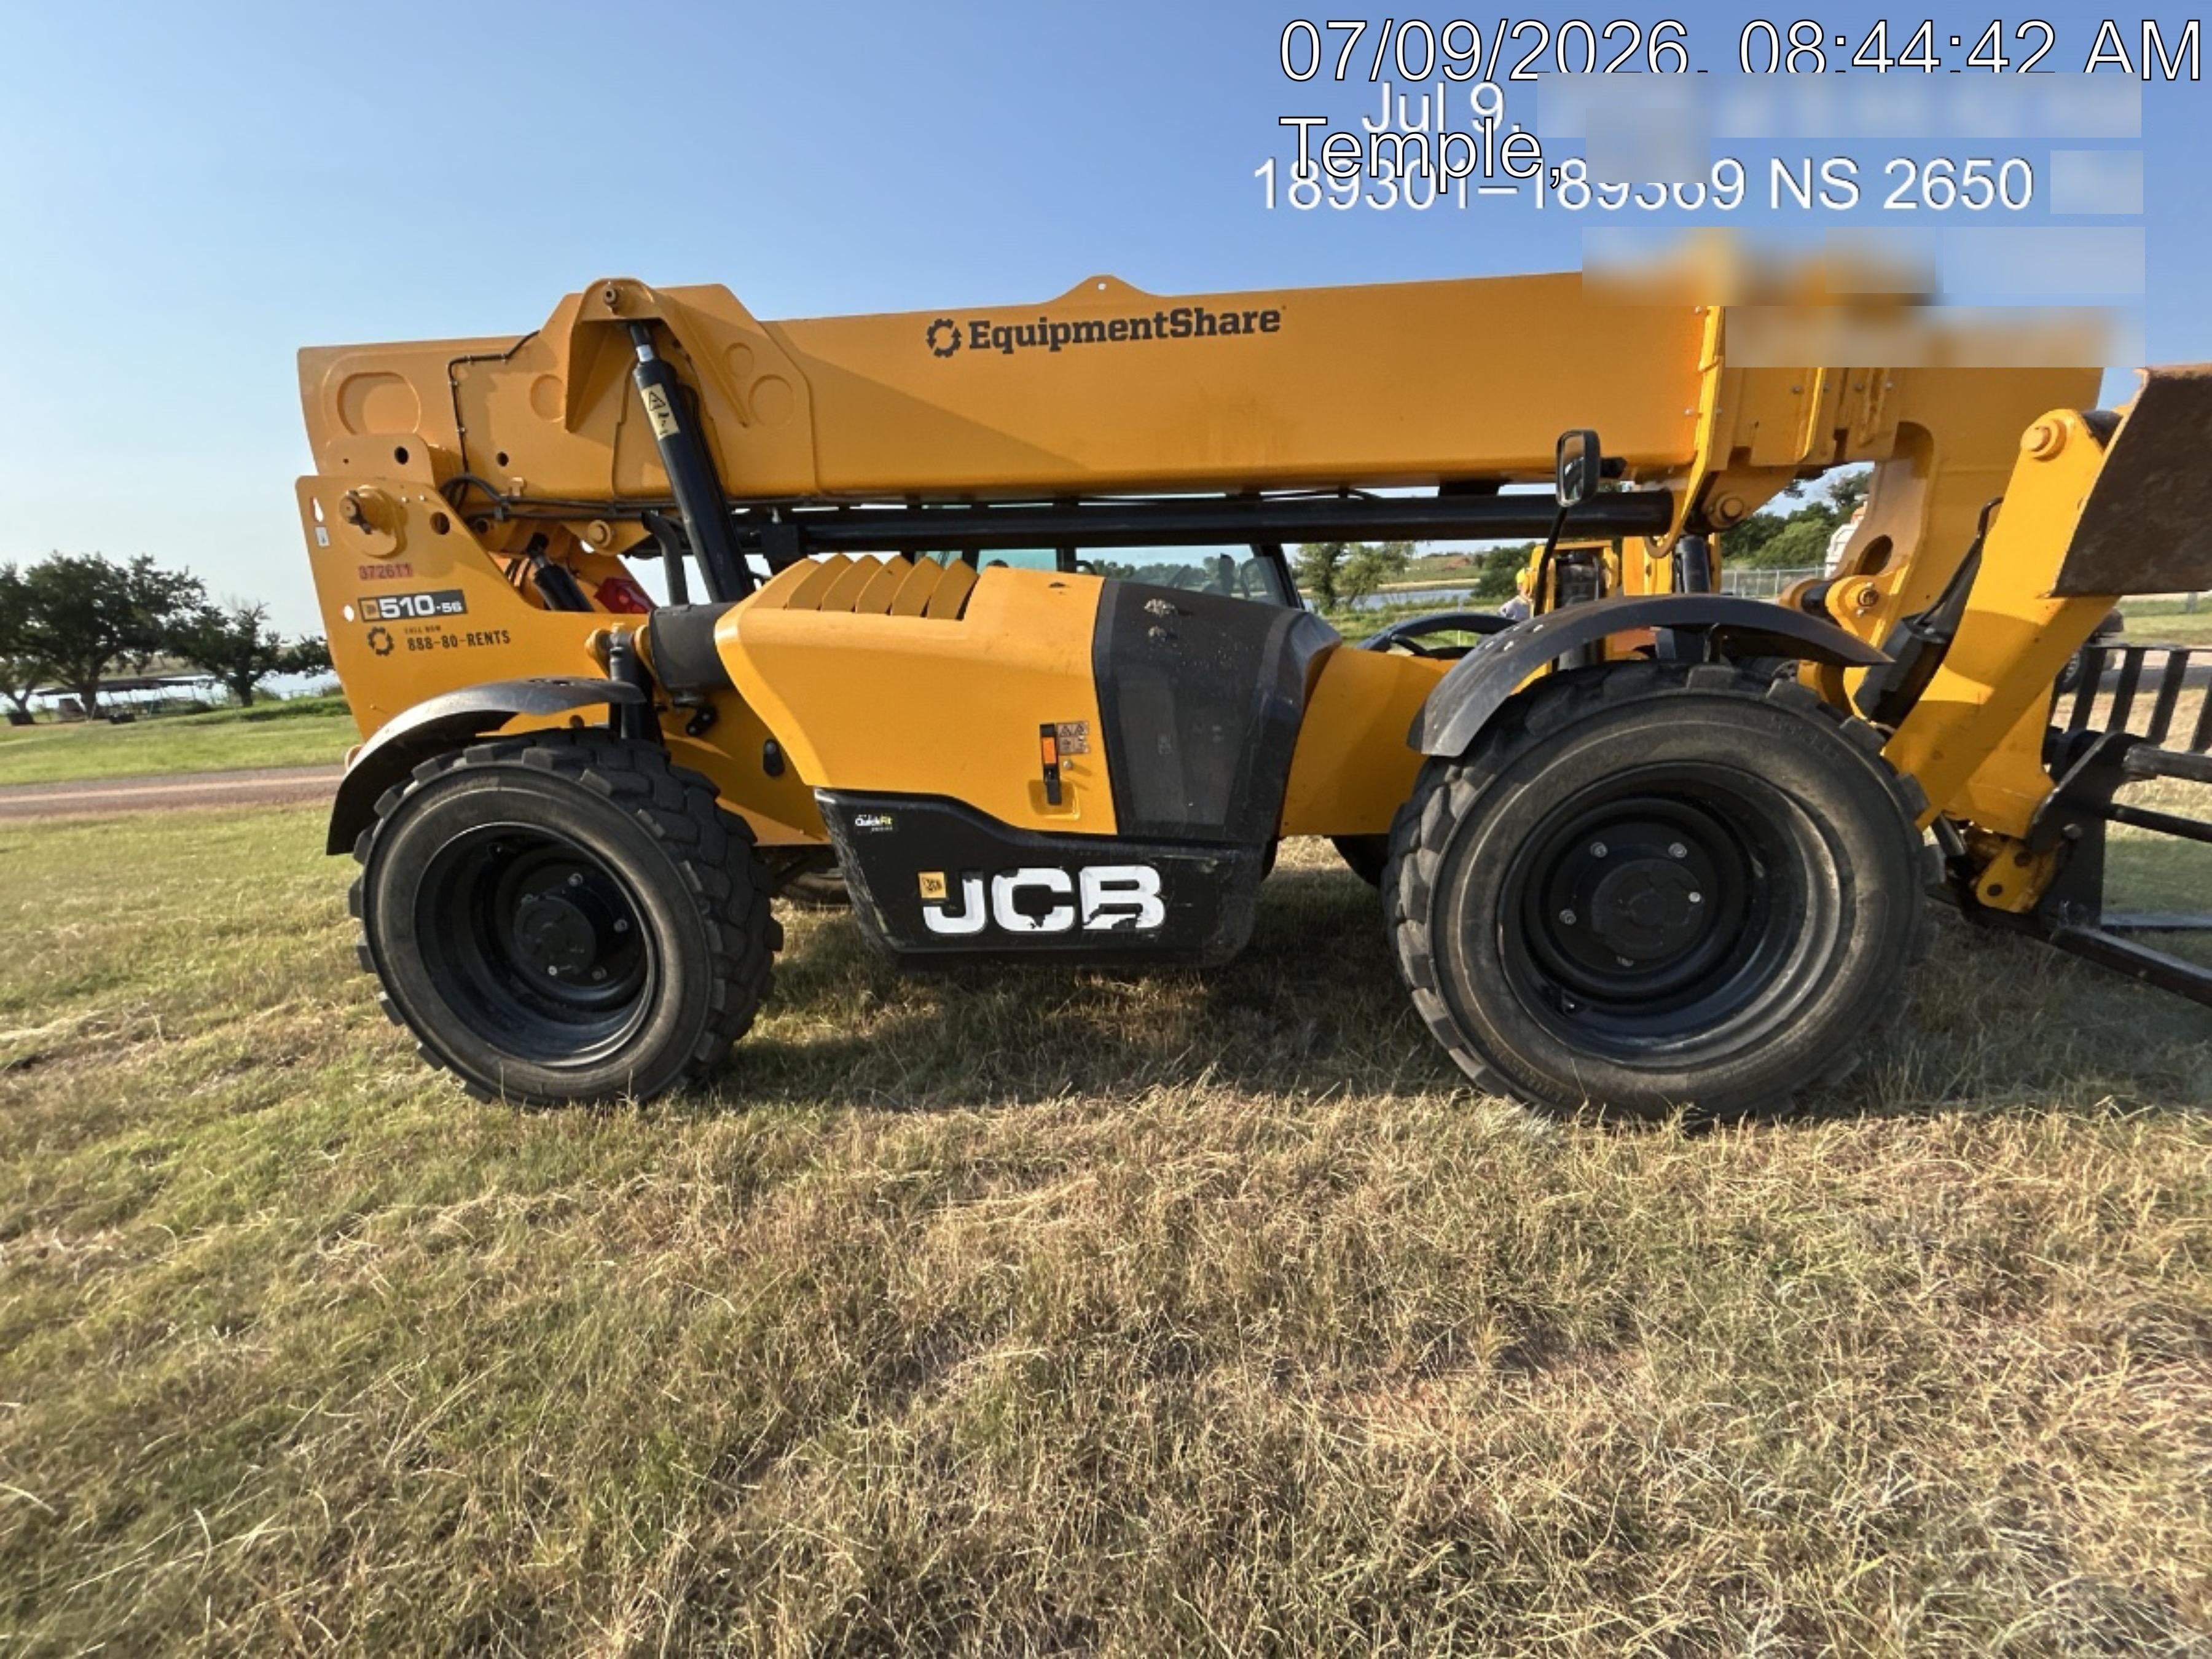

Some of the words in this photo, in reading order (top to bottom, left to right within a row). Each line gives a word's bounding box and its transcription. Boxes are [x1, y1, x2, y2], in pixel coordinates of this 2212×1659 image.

[968, 307, 1281, 354] EquipmentShare
[407, 629, 511, 651] 888-80-RENTS
[923, 865, 1165, 933] JCB
